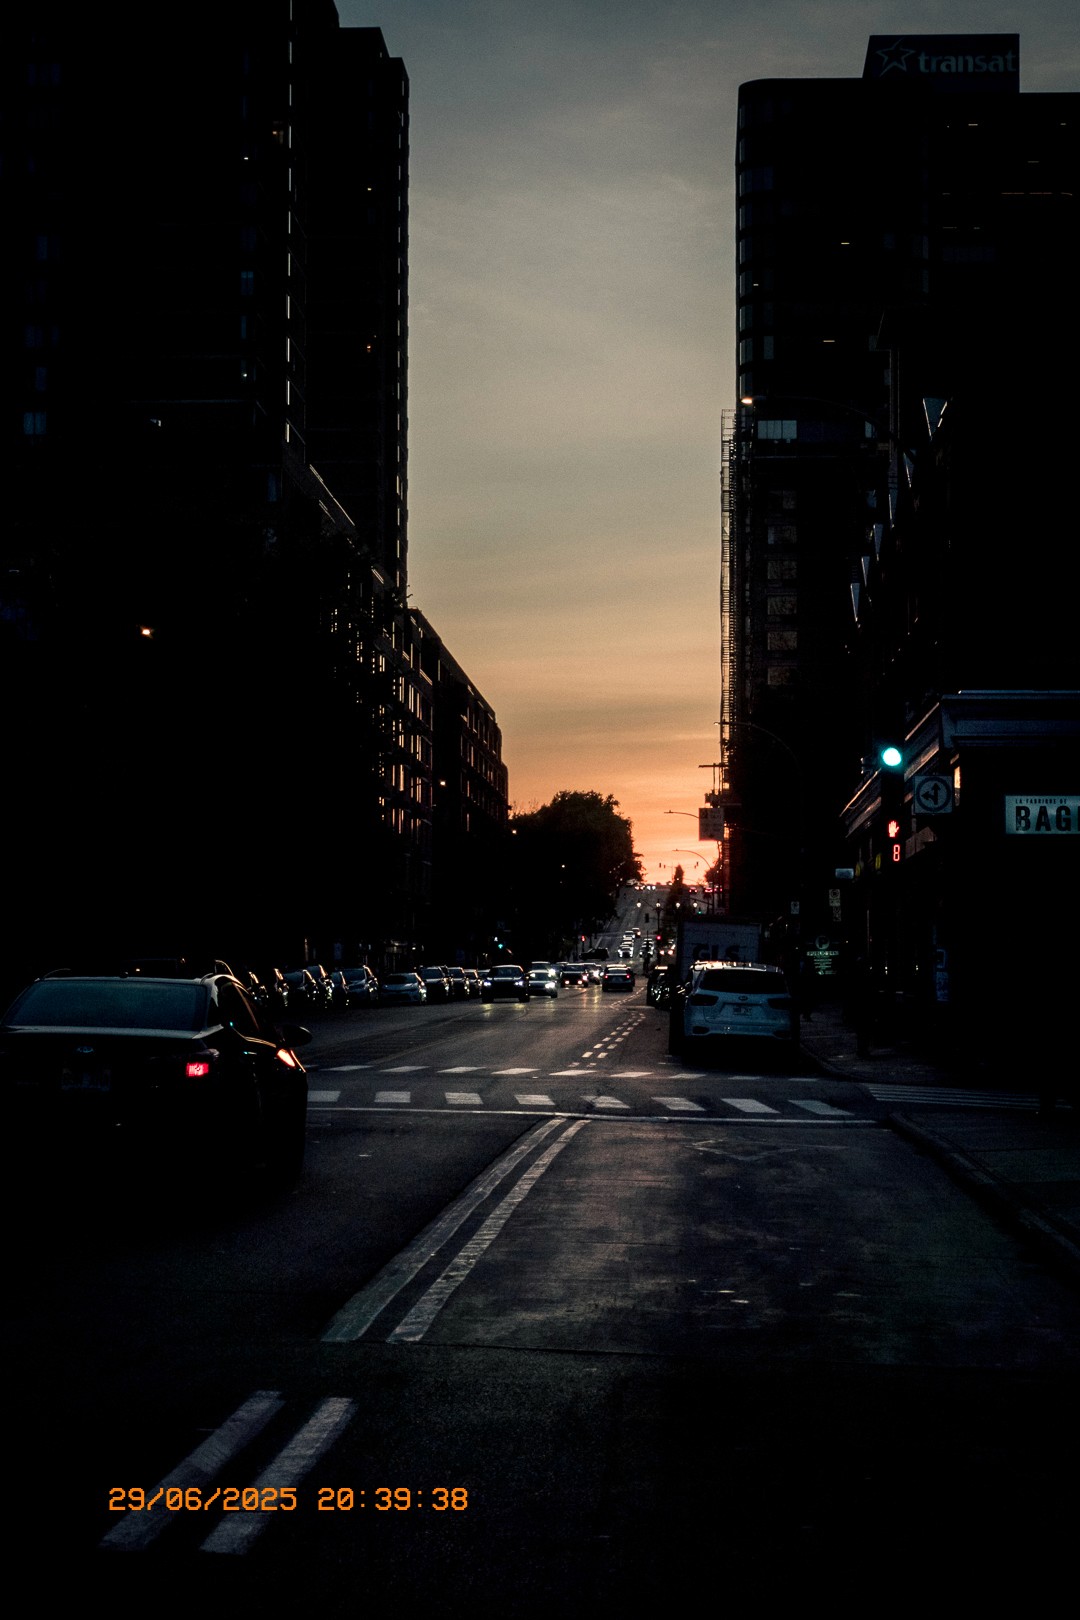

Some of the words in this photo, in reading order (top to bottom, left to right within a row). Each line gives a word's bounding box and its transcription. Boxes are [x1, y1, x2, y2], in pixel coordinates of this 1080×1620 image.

[917, 47, 1017, 74] transat
[1015, 805, 1080, 832] BAG
[892, 843, 901, 862] 8
